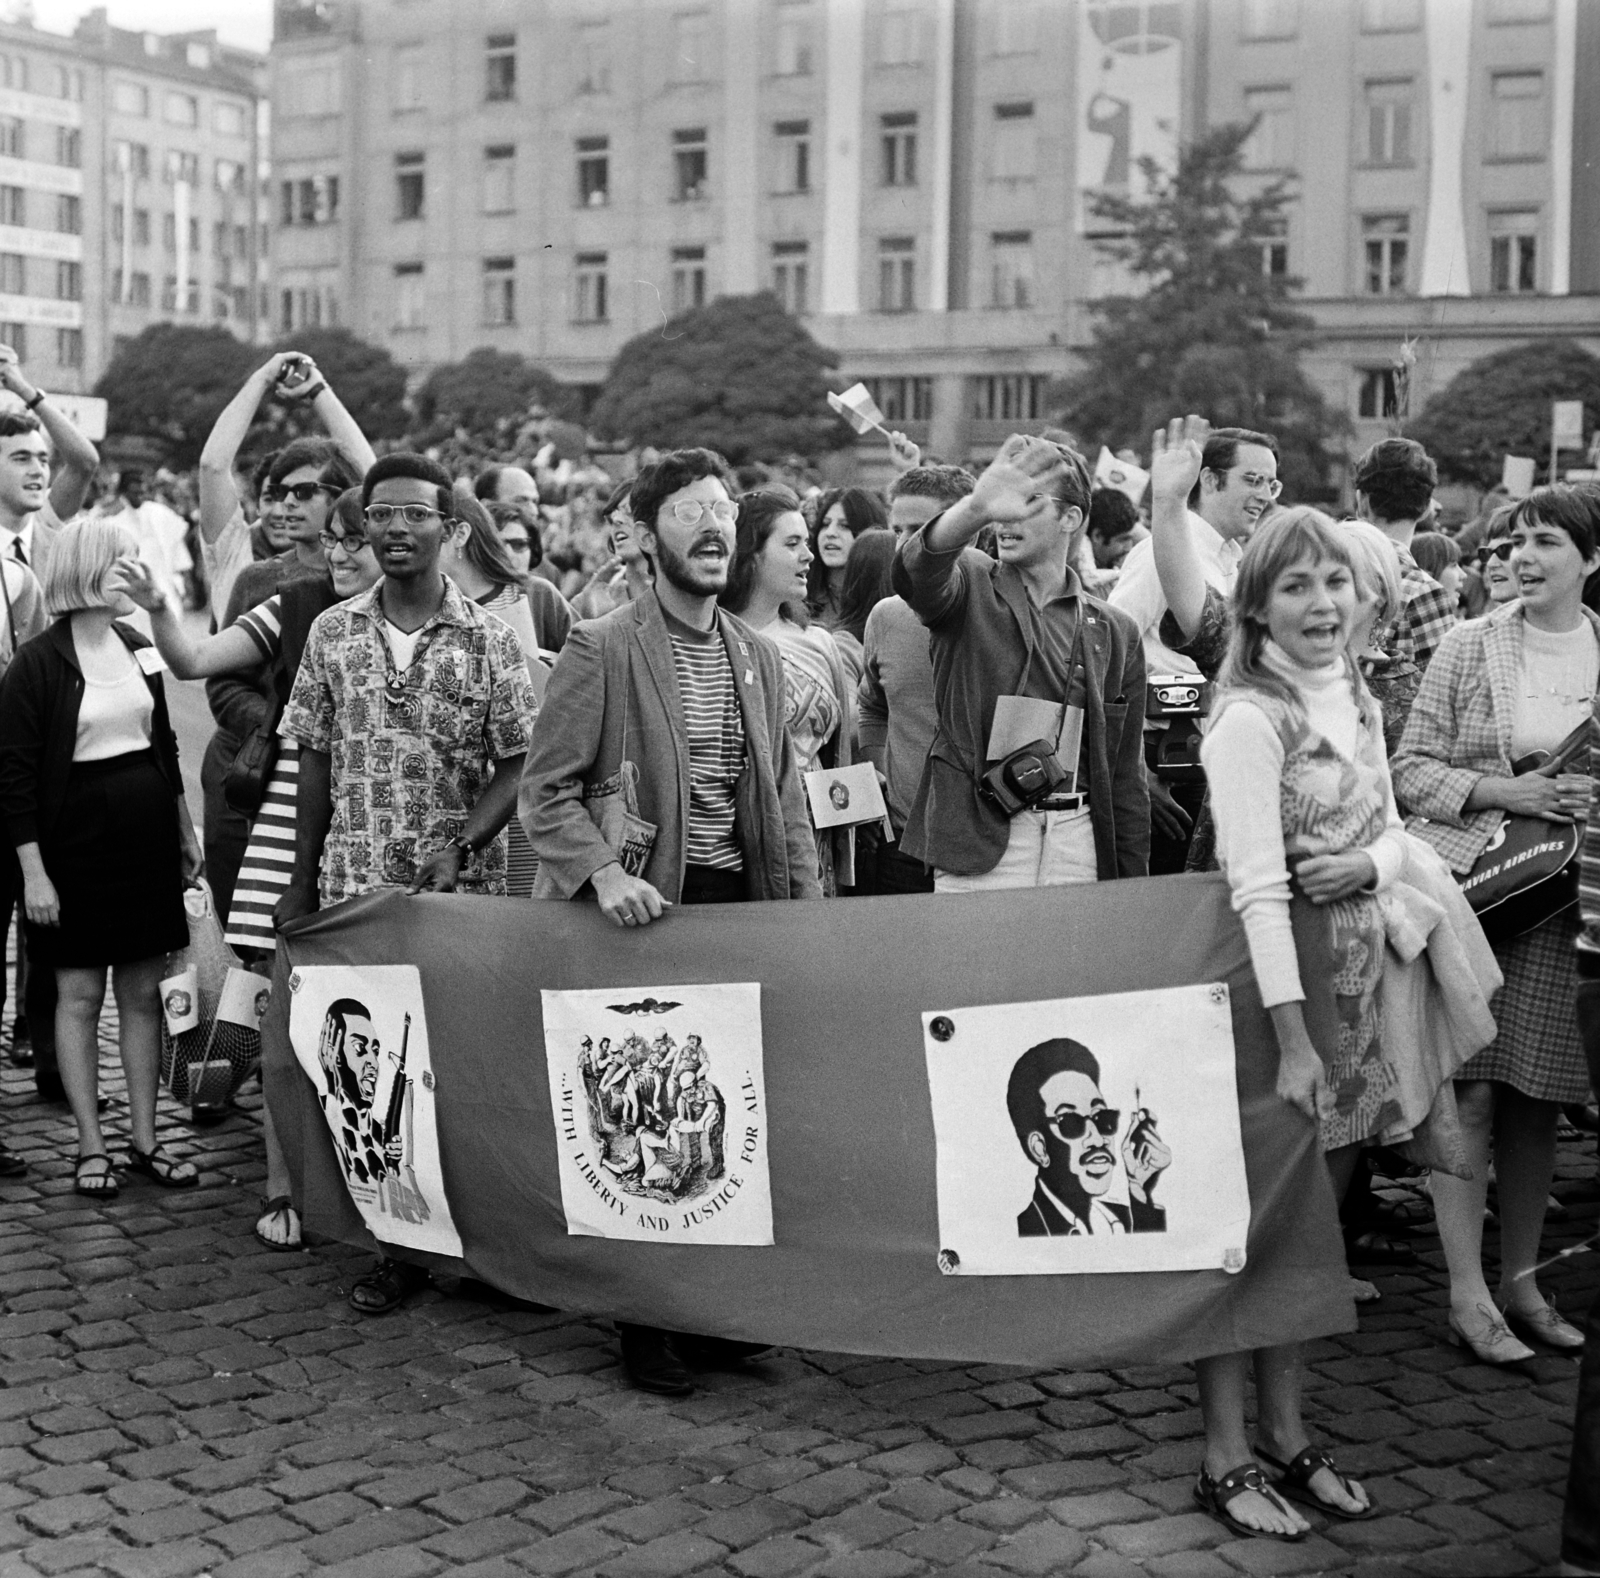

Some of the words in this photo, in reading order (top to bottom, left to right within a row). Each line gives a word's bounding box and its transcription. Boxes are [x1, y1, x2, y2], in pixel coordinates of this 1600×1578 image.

[1503, 841, 1565, 871] AIRLINES
[741, 1069, 759, 1115] ALL.
[740, 1126, 759, 1164] FOR
[573, 1151, 629, 1217] LIBERTY
[682, 1173, 744, 1230] JUSTICE
[636, 1213, 670, 1232] AND
